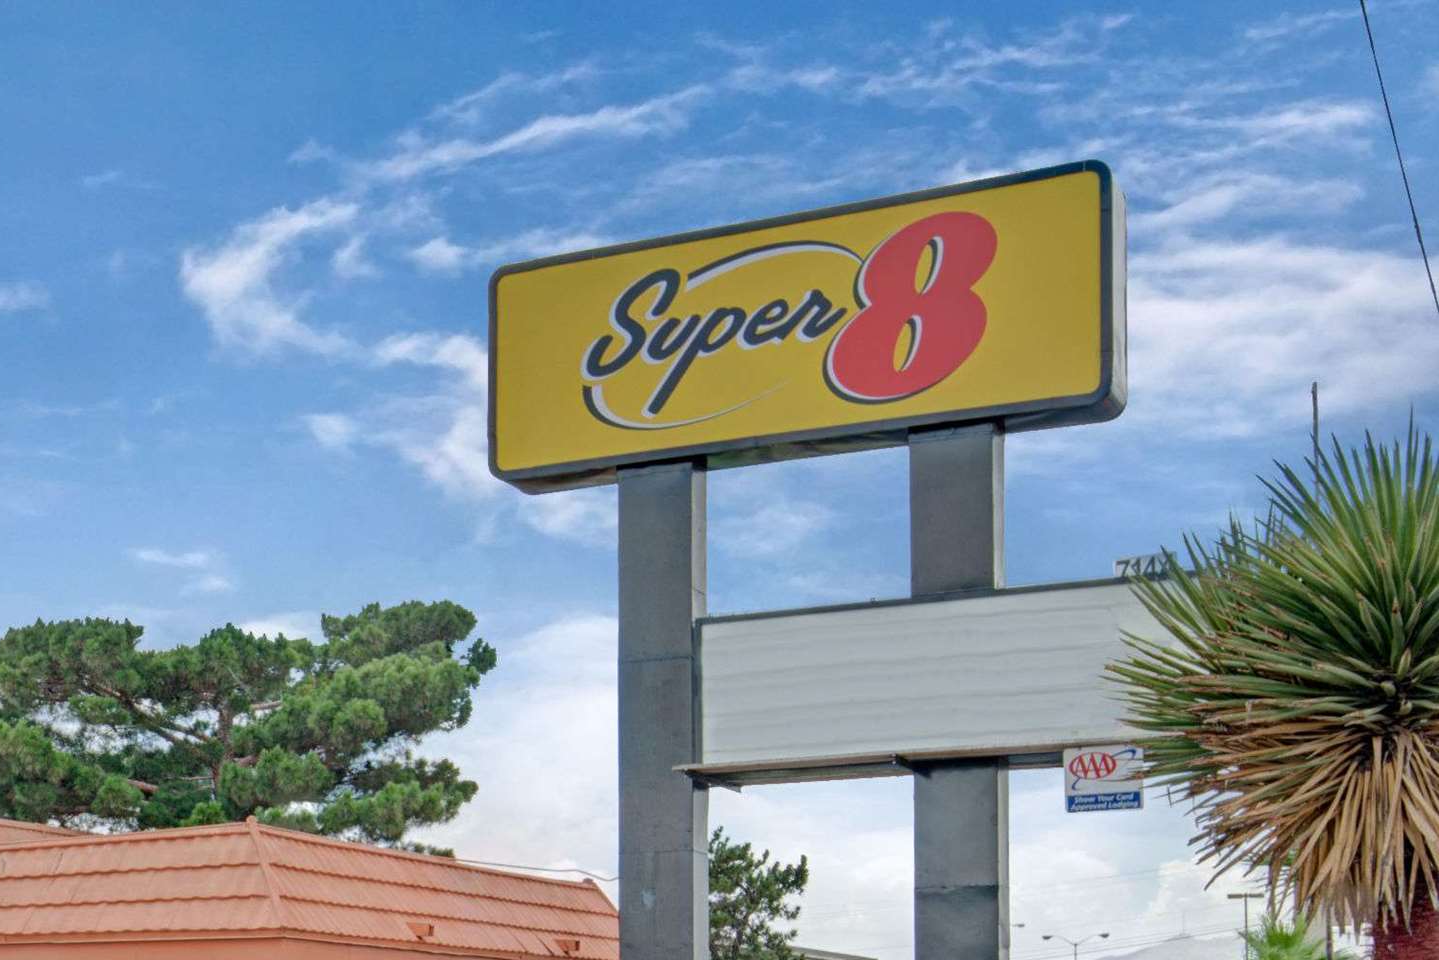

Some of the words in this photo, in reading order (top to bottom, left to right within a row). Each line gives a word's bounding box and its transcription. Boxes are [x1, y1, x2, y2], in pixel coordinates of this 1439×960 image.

[581, 268, 846, 418] Super
[824, 211, 997, 404] 8
[1071, 752, 1115, 779] AAA
[1116, 792, 1134, 802] Card
